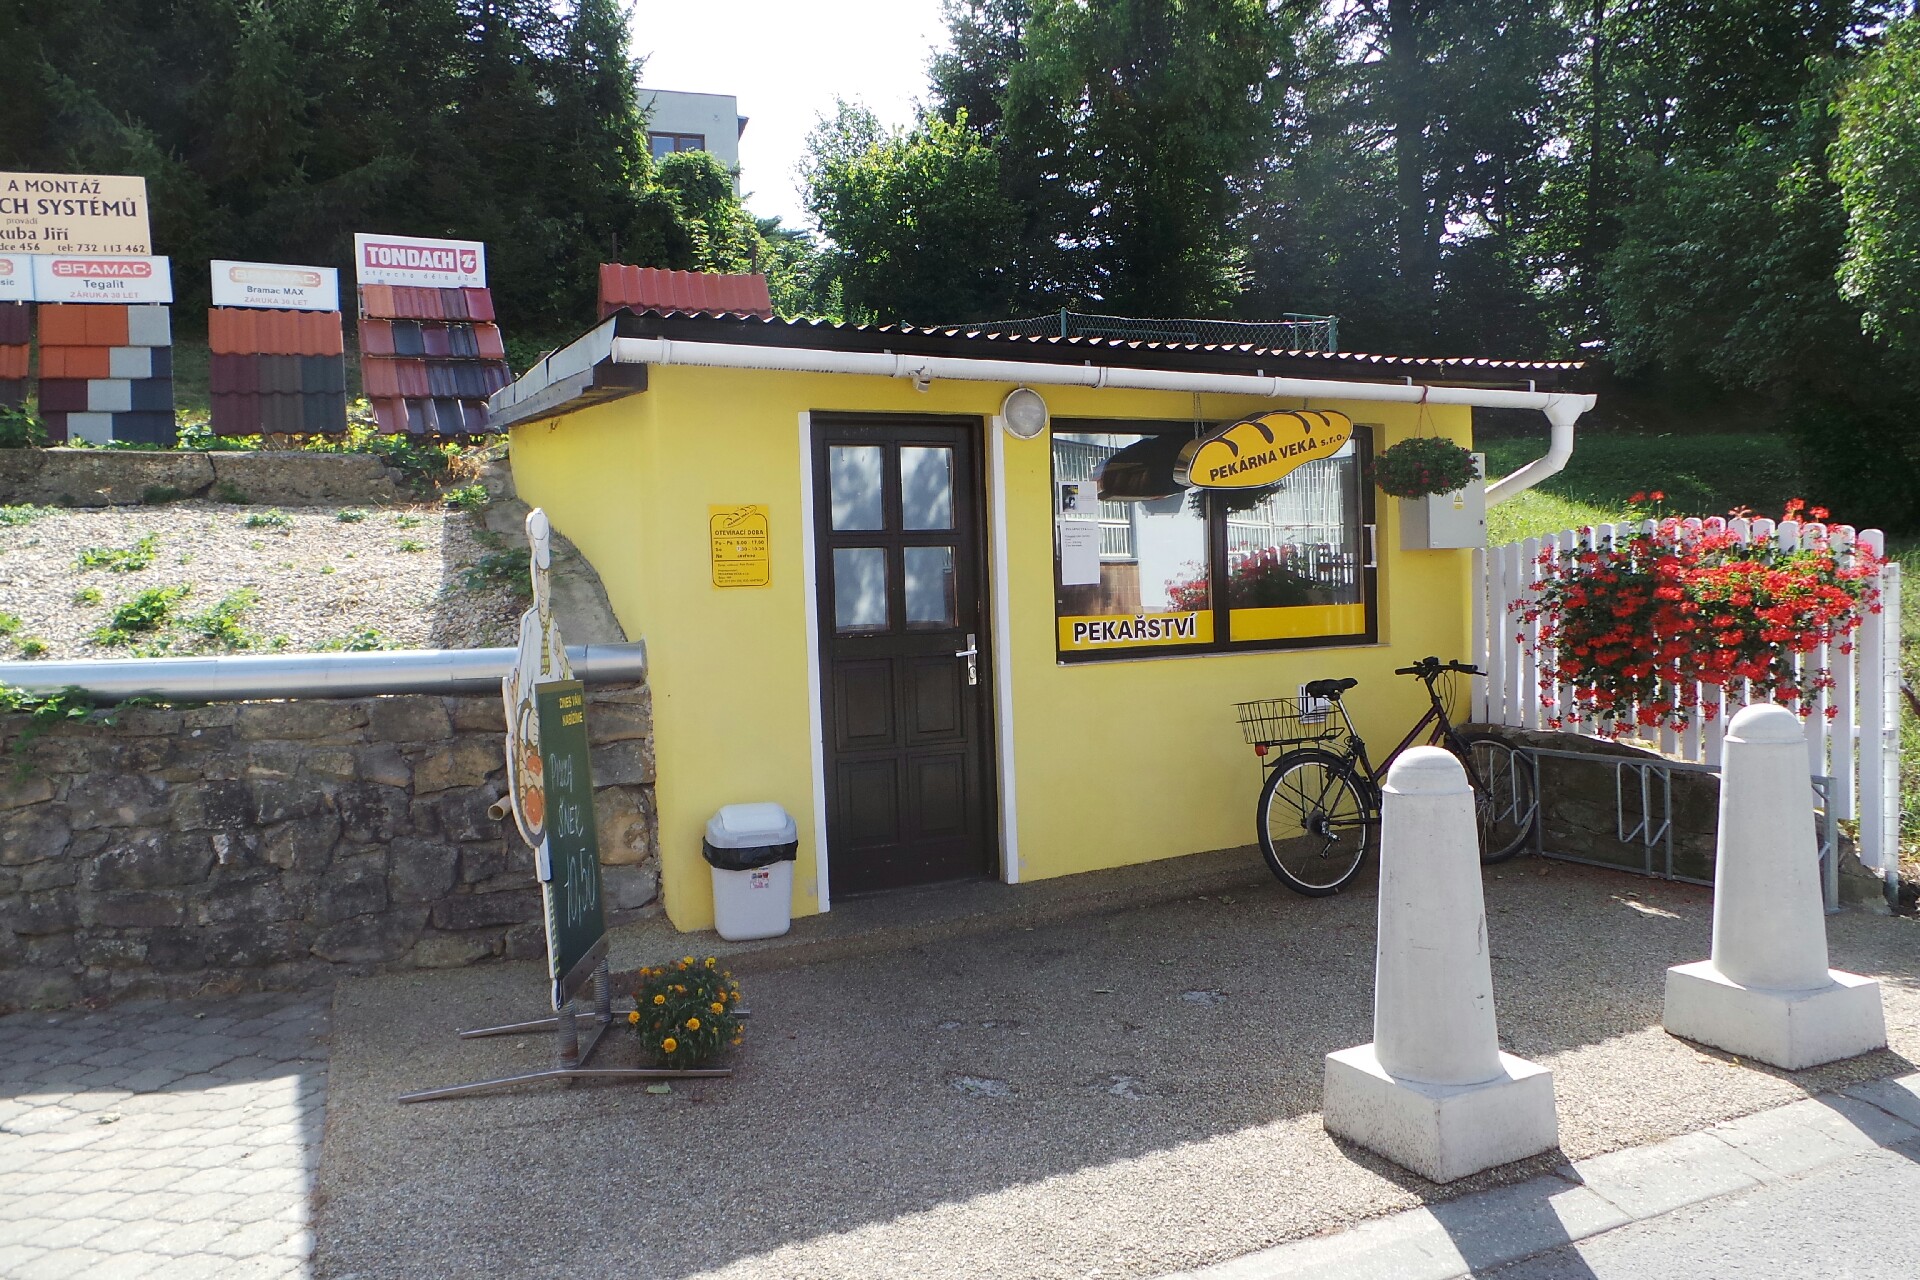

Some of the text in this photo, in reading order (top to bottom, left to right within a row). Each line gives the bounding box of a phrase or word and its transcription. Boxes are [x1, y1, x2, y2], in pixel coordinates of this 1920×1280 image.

[8, 178, 101, 194] A MONTÁŽ
[38, 197, 137, 217] SYSTÉMŮ
[6, 217, 38, 225] provádí
[43, 227, 69, 241] Jiří
[20, 243, 40, 251] 456
[58, 244, 74, 252] tel:
[77, 243, 98, 252] 732
[103, 244, 121, 252] 113
[126, 244, 146, 253] 462
[367, 247, 455, 269] TONDACH
[58, 264, 147, 275] BRAMAC
[83, 279, 124, 290] Tegalit
[124, 291, 139, 299] LET
[246, 285, 304, 296] Bramac MAX
[292, 298, 309, 306] LET
[1209, 433, 1346, 482] PEKÁRNA VEKA s.r.o.
[1073, 612, 1197, 643] PEKAŘSTVÍ
